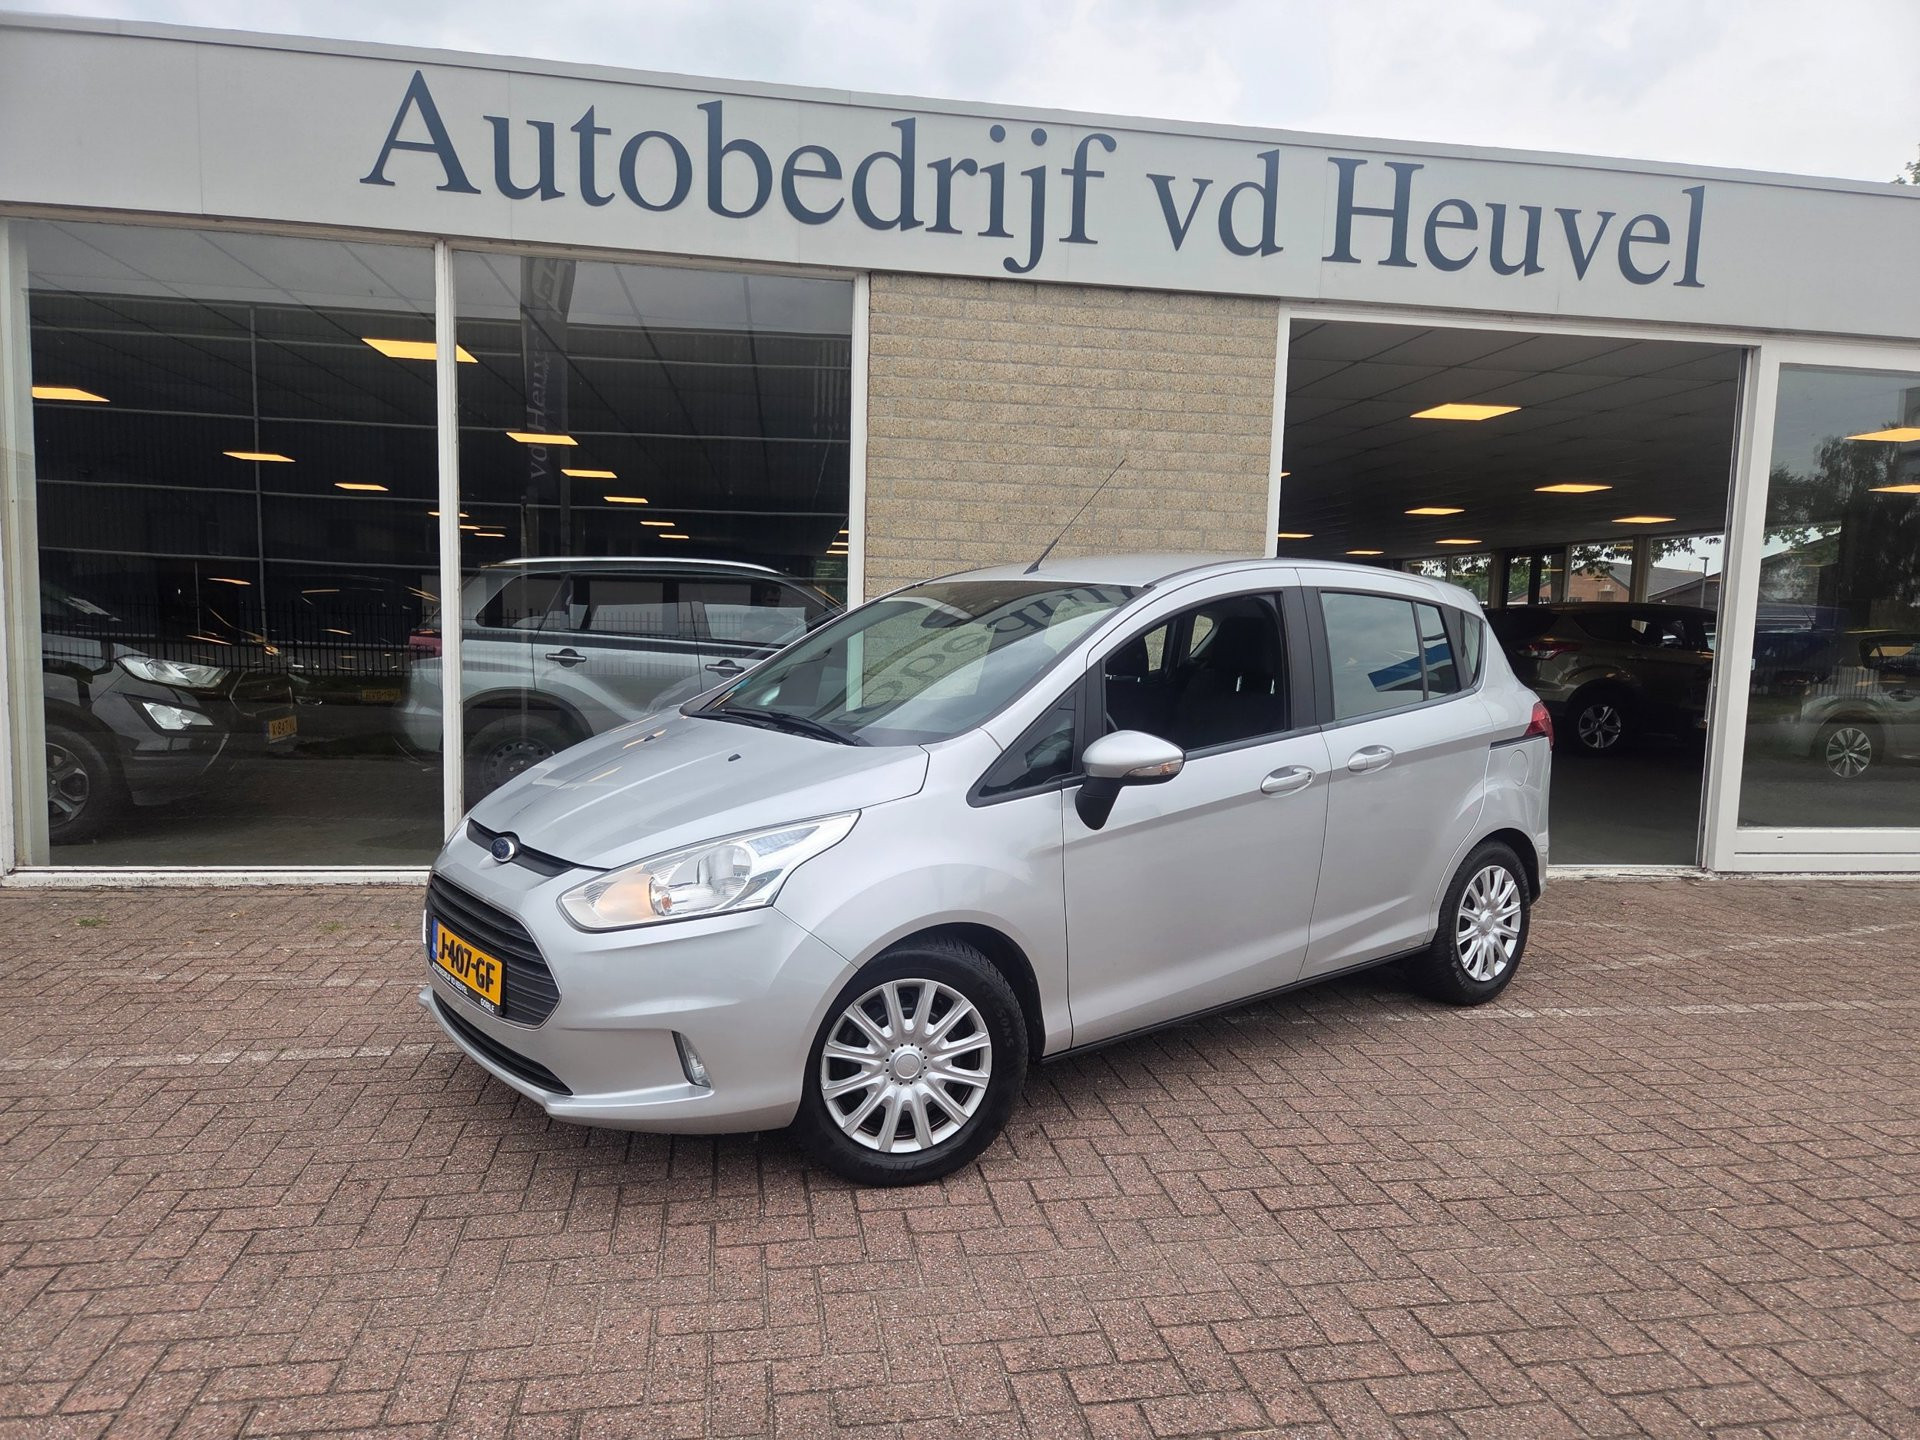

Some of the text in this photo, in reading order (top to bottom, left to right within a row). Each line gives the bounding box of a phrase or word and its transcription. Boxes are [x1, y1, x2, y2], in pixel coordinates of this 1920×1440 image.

[359, 69, 1706, 288] Autobedrijf vd Heuvel
[439, 932, 496, 993] J-407-GF
